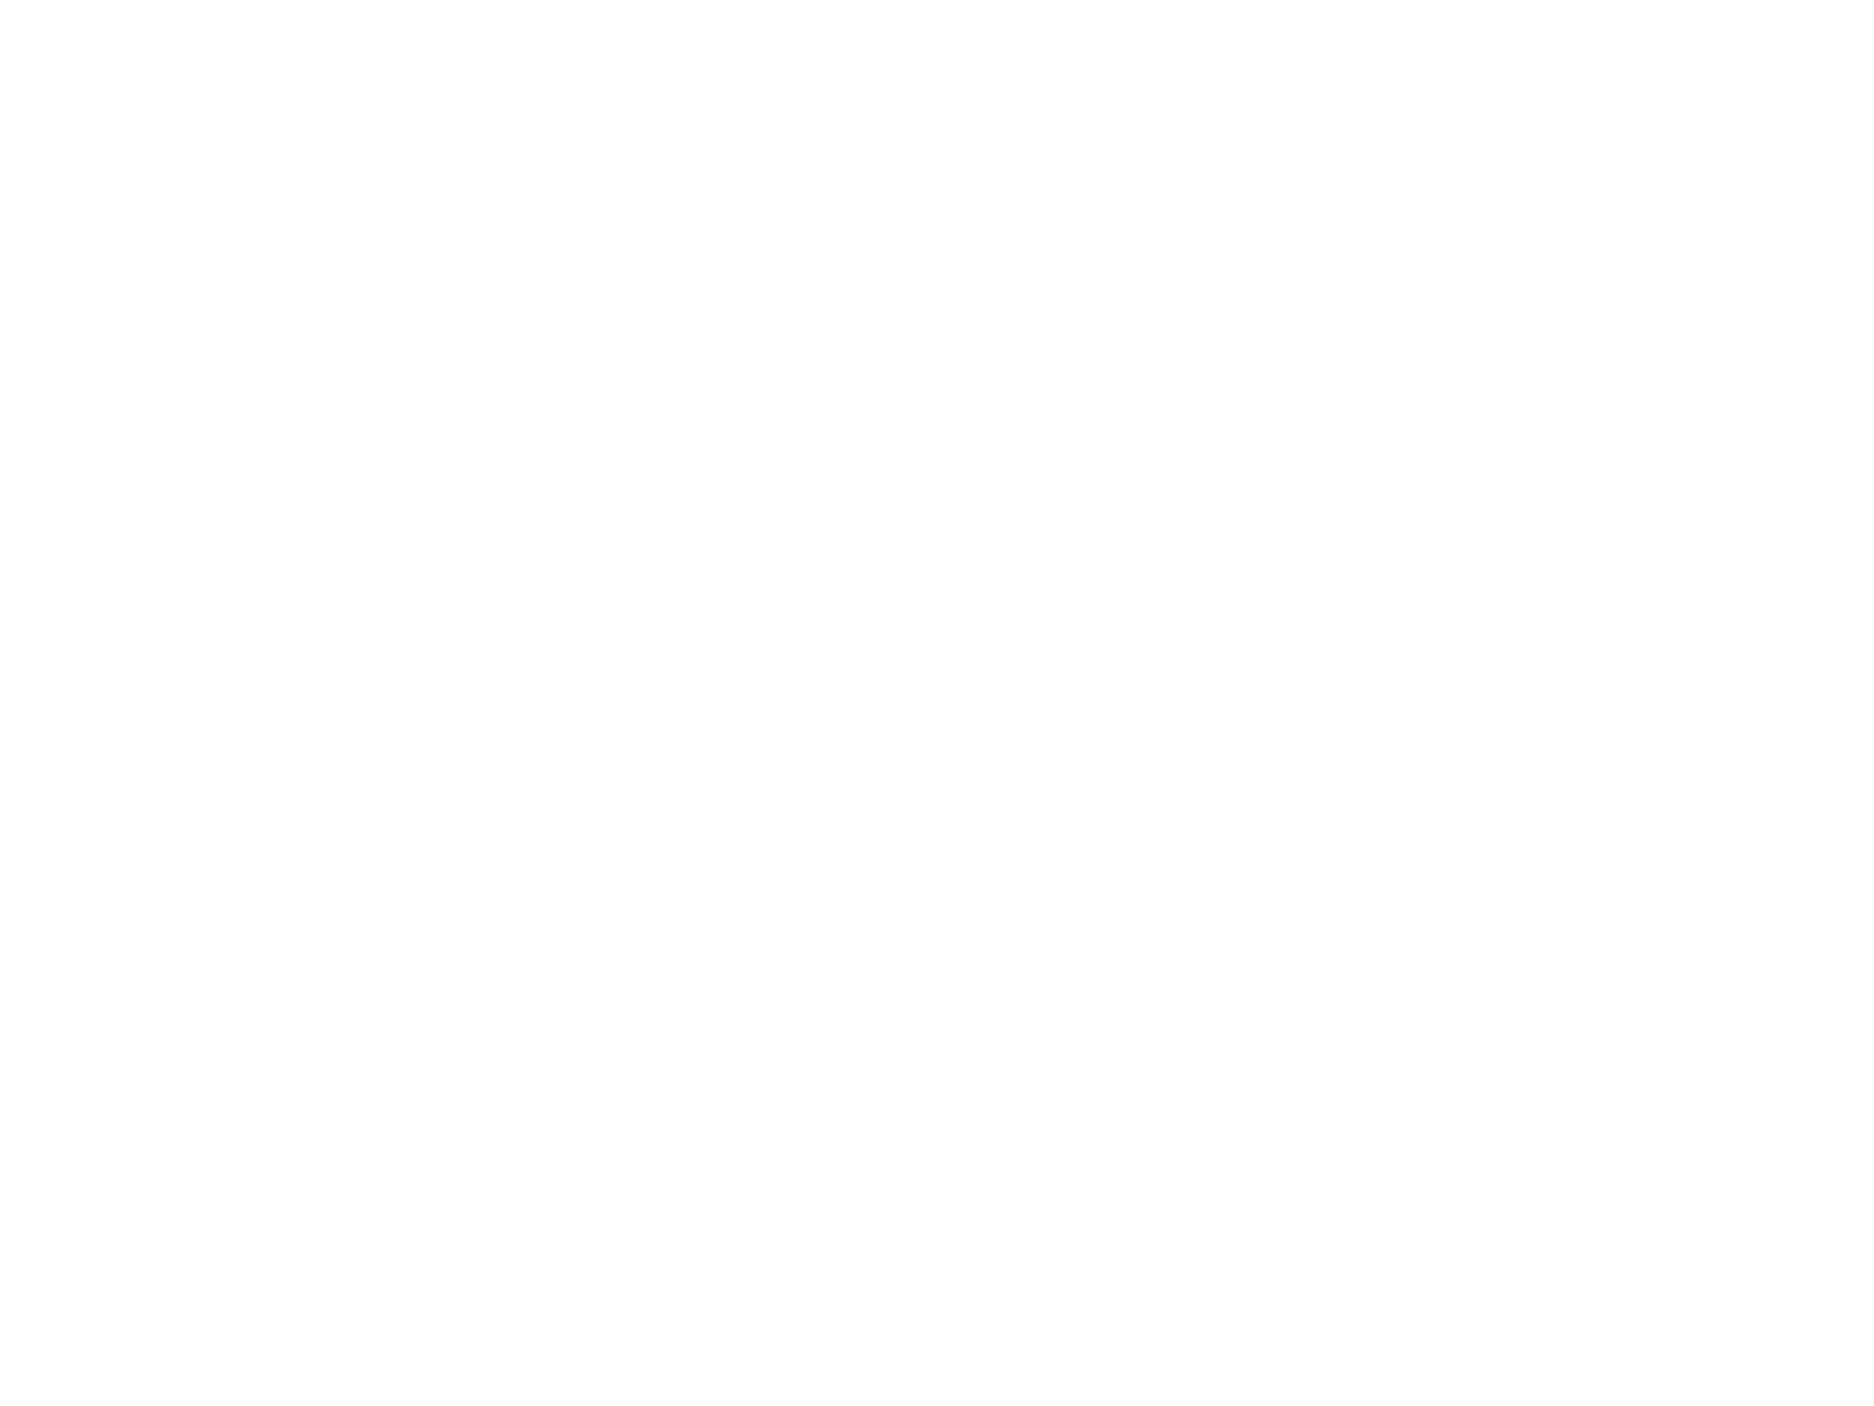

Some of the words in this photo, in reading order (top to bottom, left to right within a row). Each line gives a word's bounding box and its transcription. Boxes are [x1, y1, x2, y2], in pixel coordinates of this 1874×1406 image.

[472, 408, 1397, 505] TENNESSEE
[306, 584, 1584, 860] RESTAURANT
[733, 944, 1142, 1040] WEEK
[780, 1146, 1095, 1243] 2026
